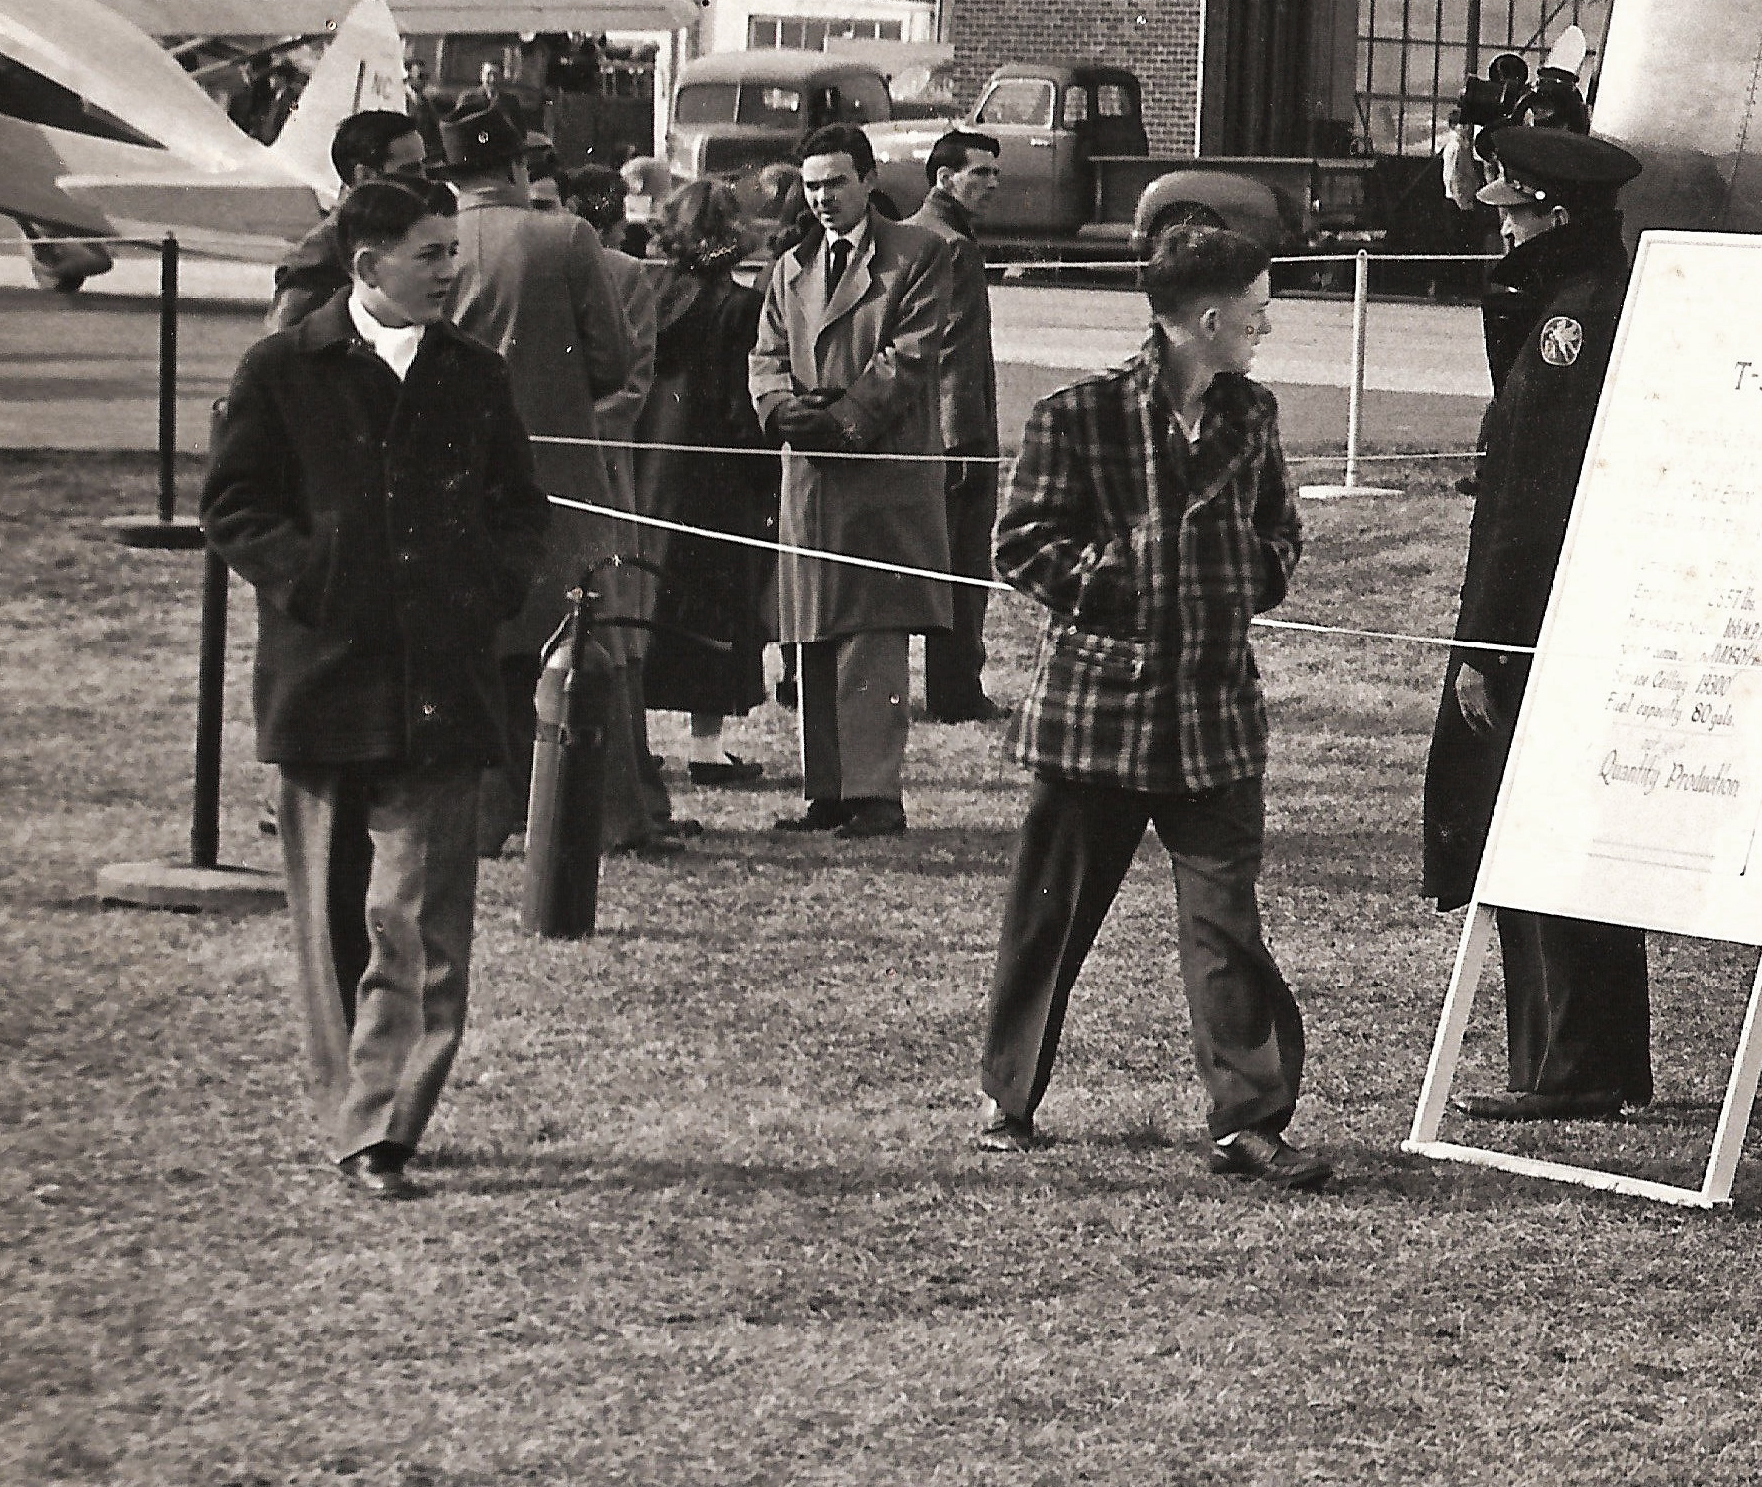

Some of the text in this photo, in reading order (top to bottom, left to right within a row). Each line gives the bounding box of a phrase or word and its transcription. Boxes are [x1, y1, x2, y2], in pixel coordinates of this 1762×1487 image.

[1690, 702, 1712, 724] 80
[1598, 749, 1741, 798] Quantity Production
